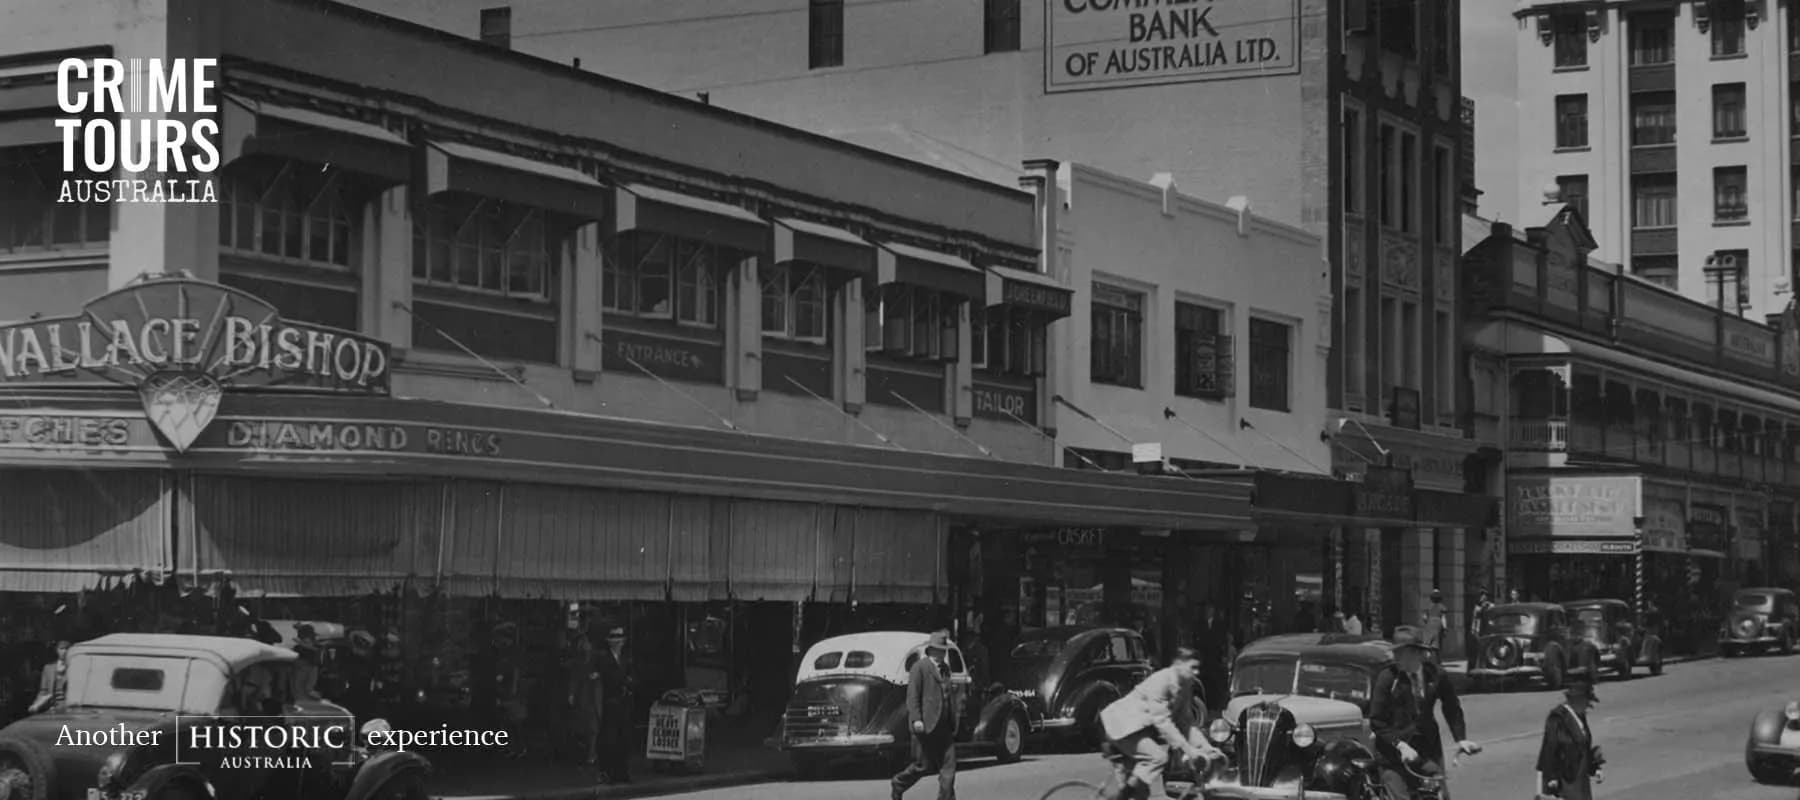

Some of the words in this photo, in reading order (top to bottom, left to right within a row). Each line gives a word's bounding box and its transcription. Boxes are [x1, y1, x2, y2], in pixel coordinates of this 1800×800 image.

[1129, 6, 1219, 42] BANK
[1065, 51, 1099, 77] OF
[1104, 40, 1228, 75] AUSTRALIA
[1235, 37, 1281, 64] LTD.
[224, 315, 386, 386] BISHOP
[616, 341, 689, 367] ENTRANCE
[973, 389, 1025, 418] TAILOR
[226, 419, 408, 449] DIAMOND
[1057, 527, 1105, 545] CASKET
